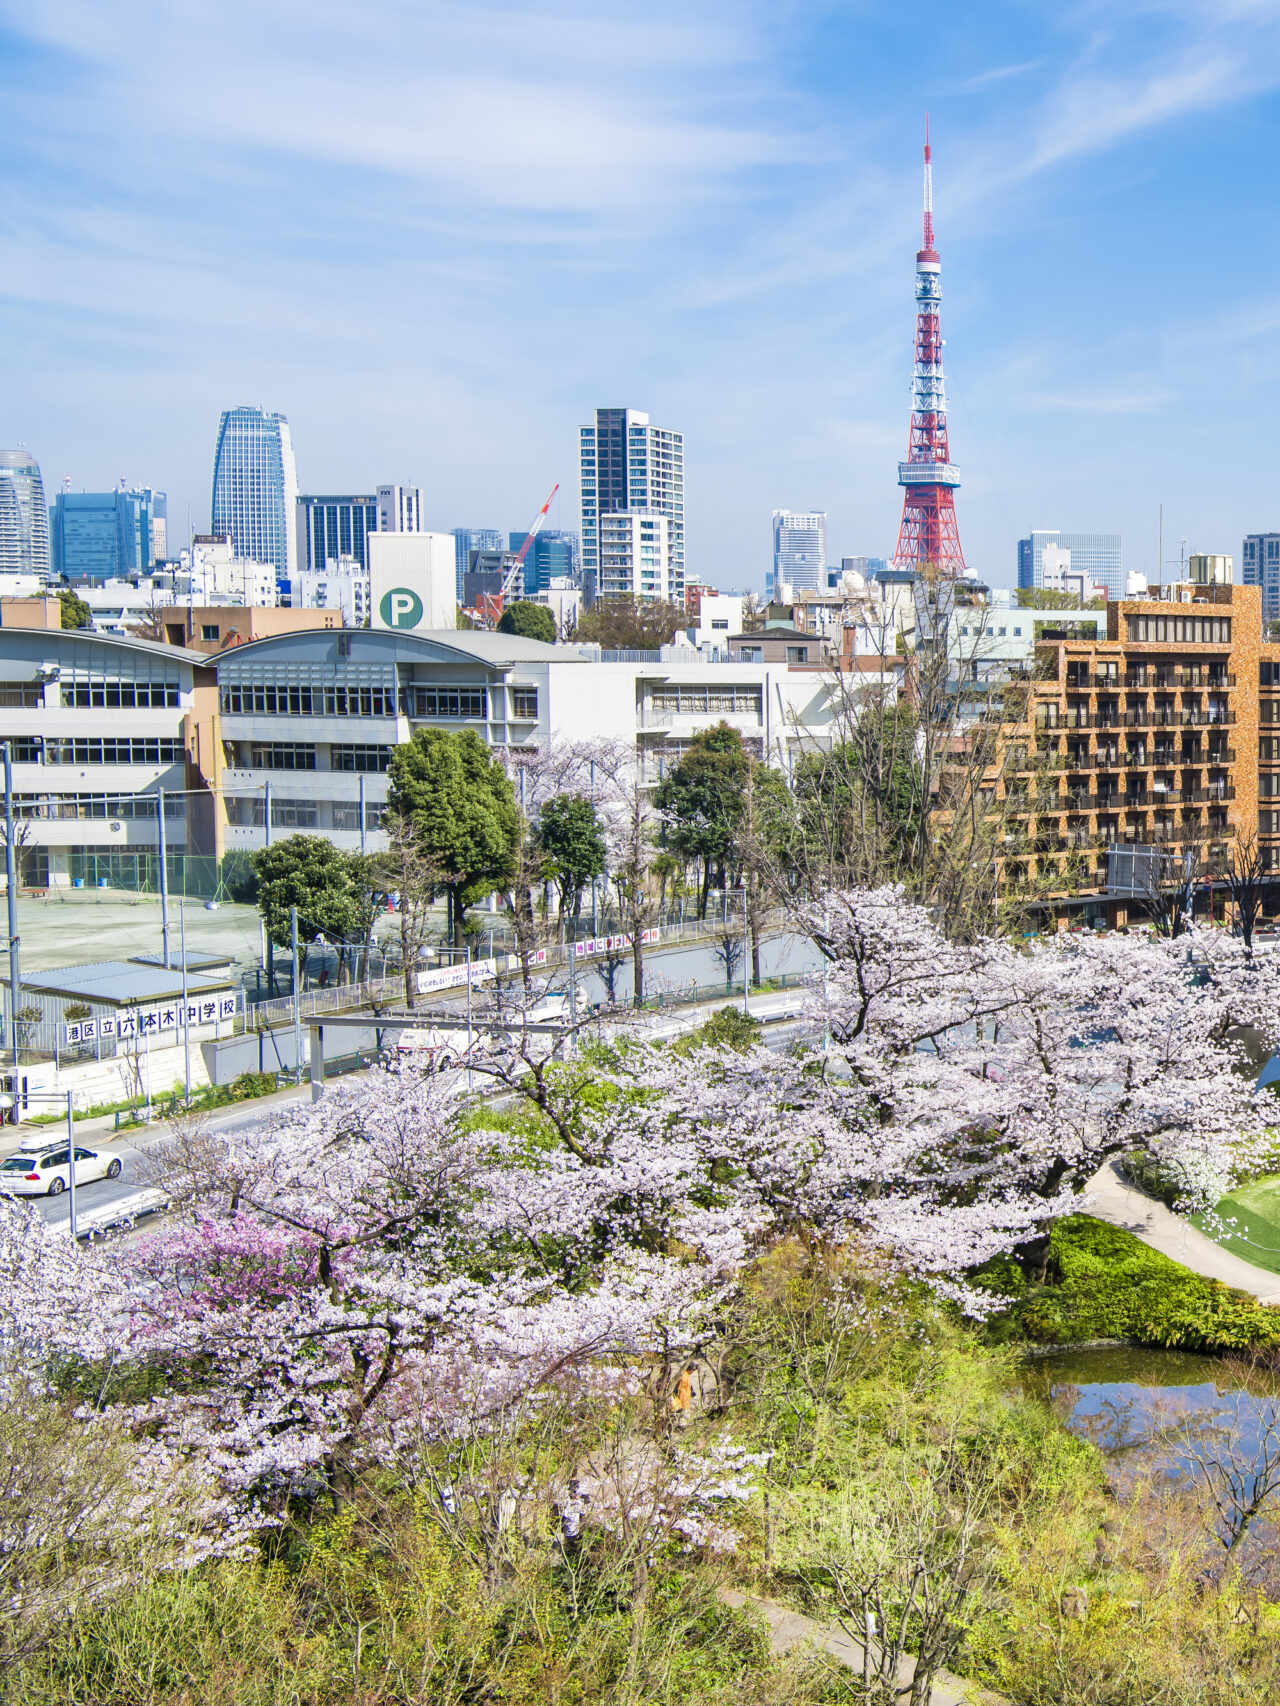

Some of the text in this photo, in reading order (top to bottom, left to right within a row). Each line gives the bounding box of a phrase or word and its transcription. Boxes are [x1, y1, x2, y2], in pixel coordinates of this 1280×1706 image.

[391, 593, 414, 626] P
[68, 999, 235, 1041] 港区立六本木中学校
